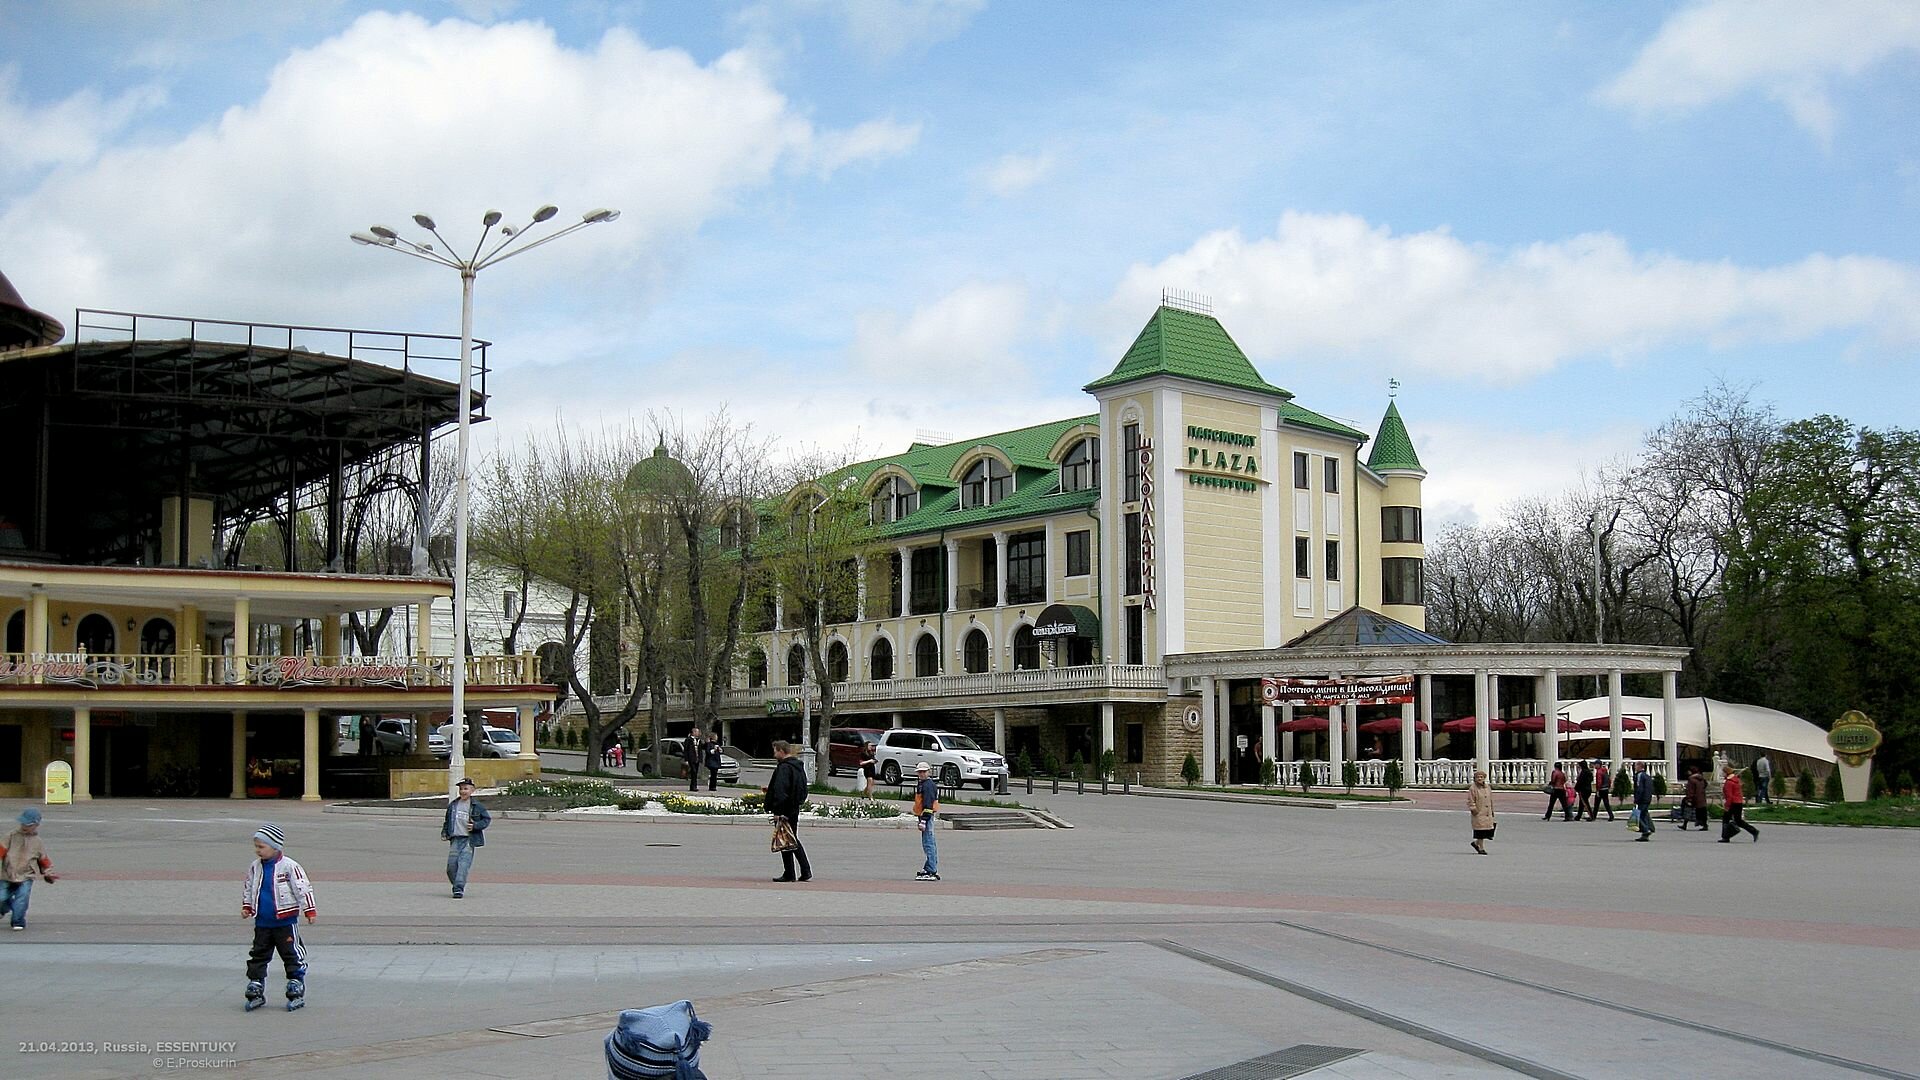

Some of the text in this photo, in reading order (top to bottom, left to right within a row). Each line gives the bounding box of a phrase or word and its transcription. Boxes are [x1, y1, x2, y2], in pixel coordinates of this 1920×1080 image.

[1187, 425, 1257, 447] ПАНСИОНАТ
[1188, 447, 1258, 473] PLAZA
[1137, 434, 1156, 611] ШОКОЛАДНИЦА
[0, 659, 87, 677] аляпин
[31, 653, 88, 663] ТРАКТИР
